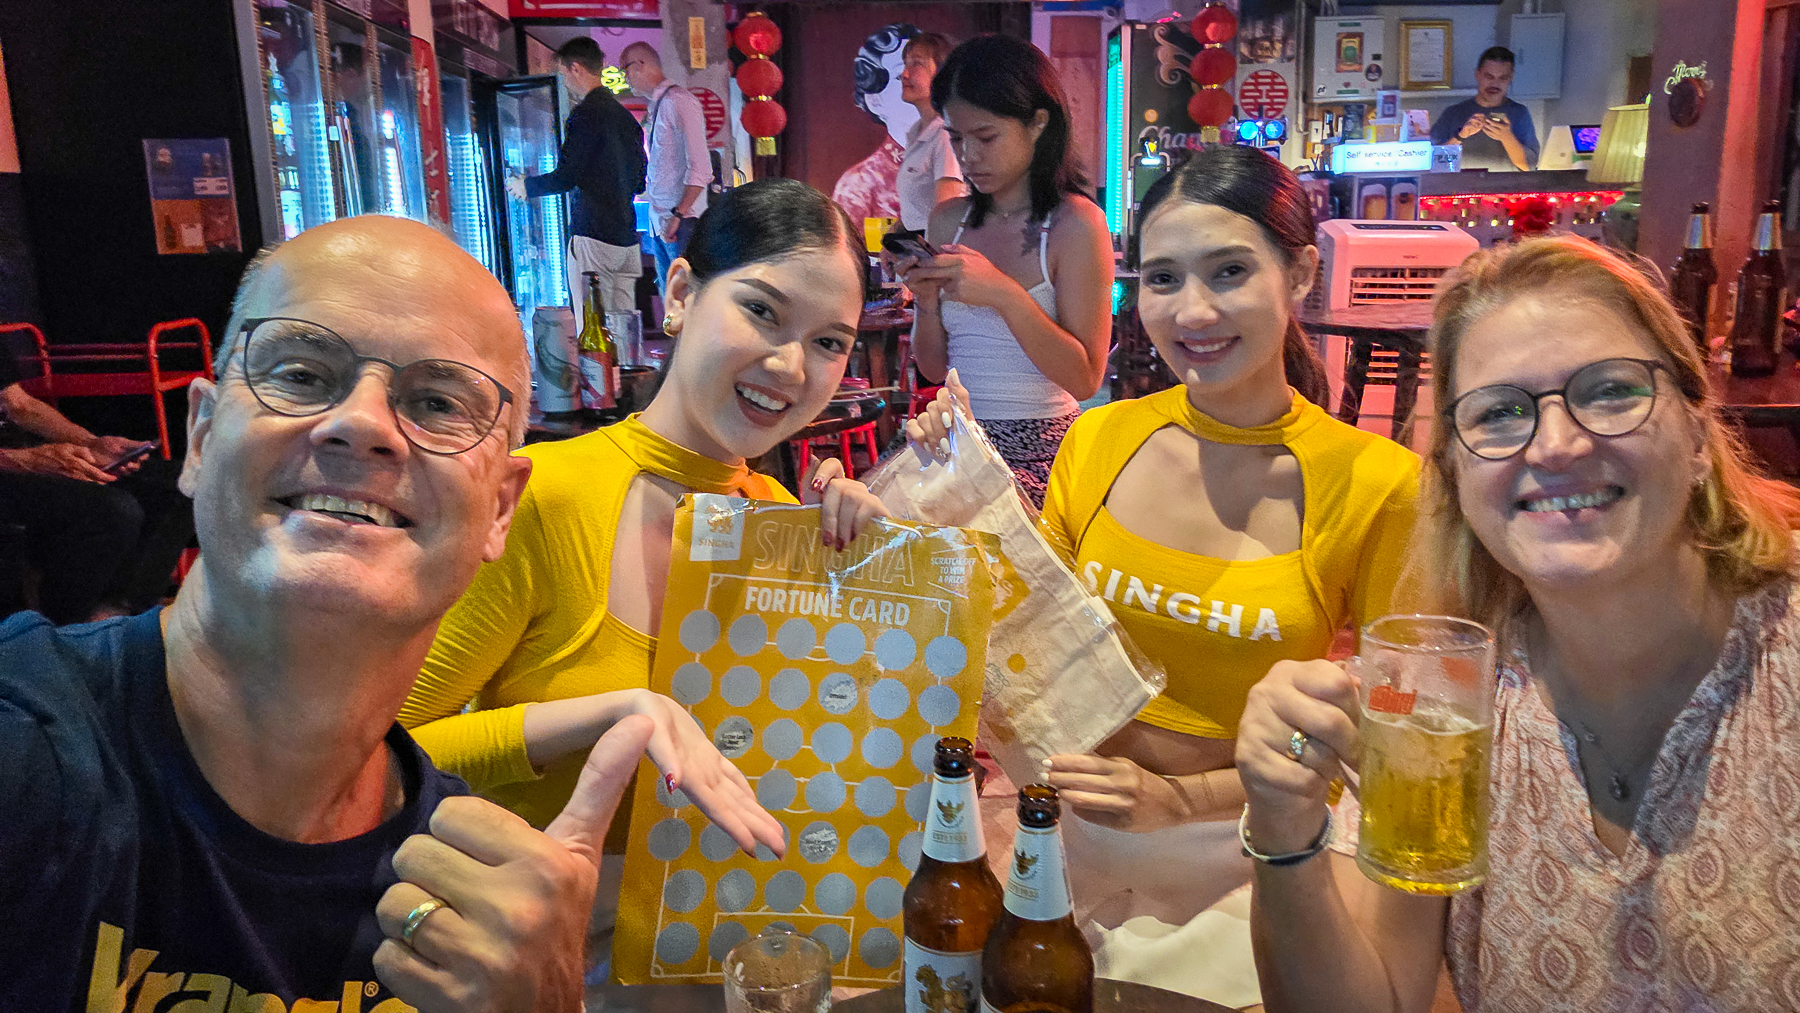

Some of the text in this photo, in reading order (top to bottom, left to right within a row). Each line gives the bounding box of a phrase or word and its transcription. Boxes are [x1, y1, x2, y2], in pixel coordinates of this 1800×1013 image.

[1398, 148, 1428, 158] Cashier
[698, 537, 736, 549] SINGHA
[940, 566, 965, 576] TO WIN
[944, 575, 965, 584] PRIZE
[744, 586, 911, 627] FORTUNE CARD
[1083, 560, 1284, 643] SINGHA
